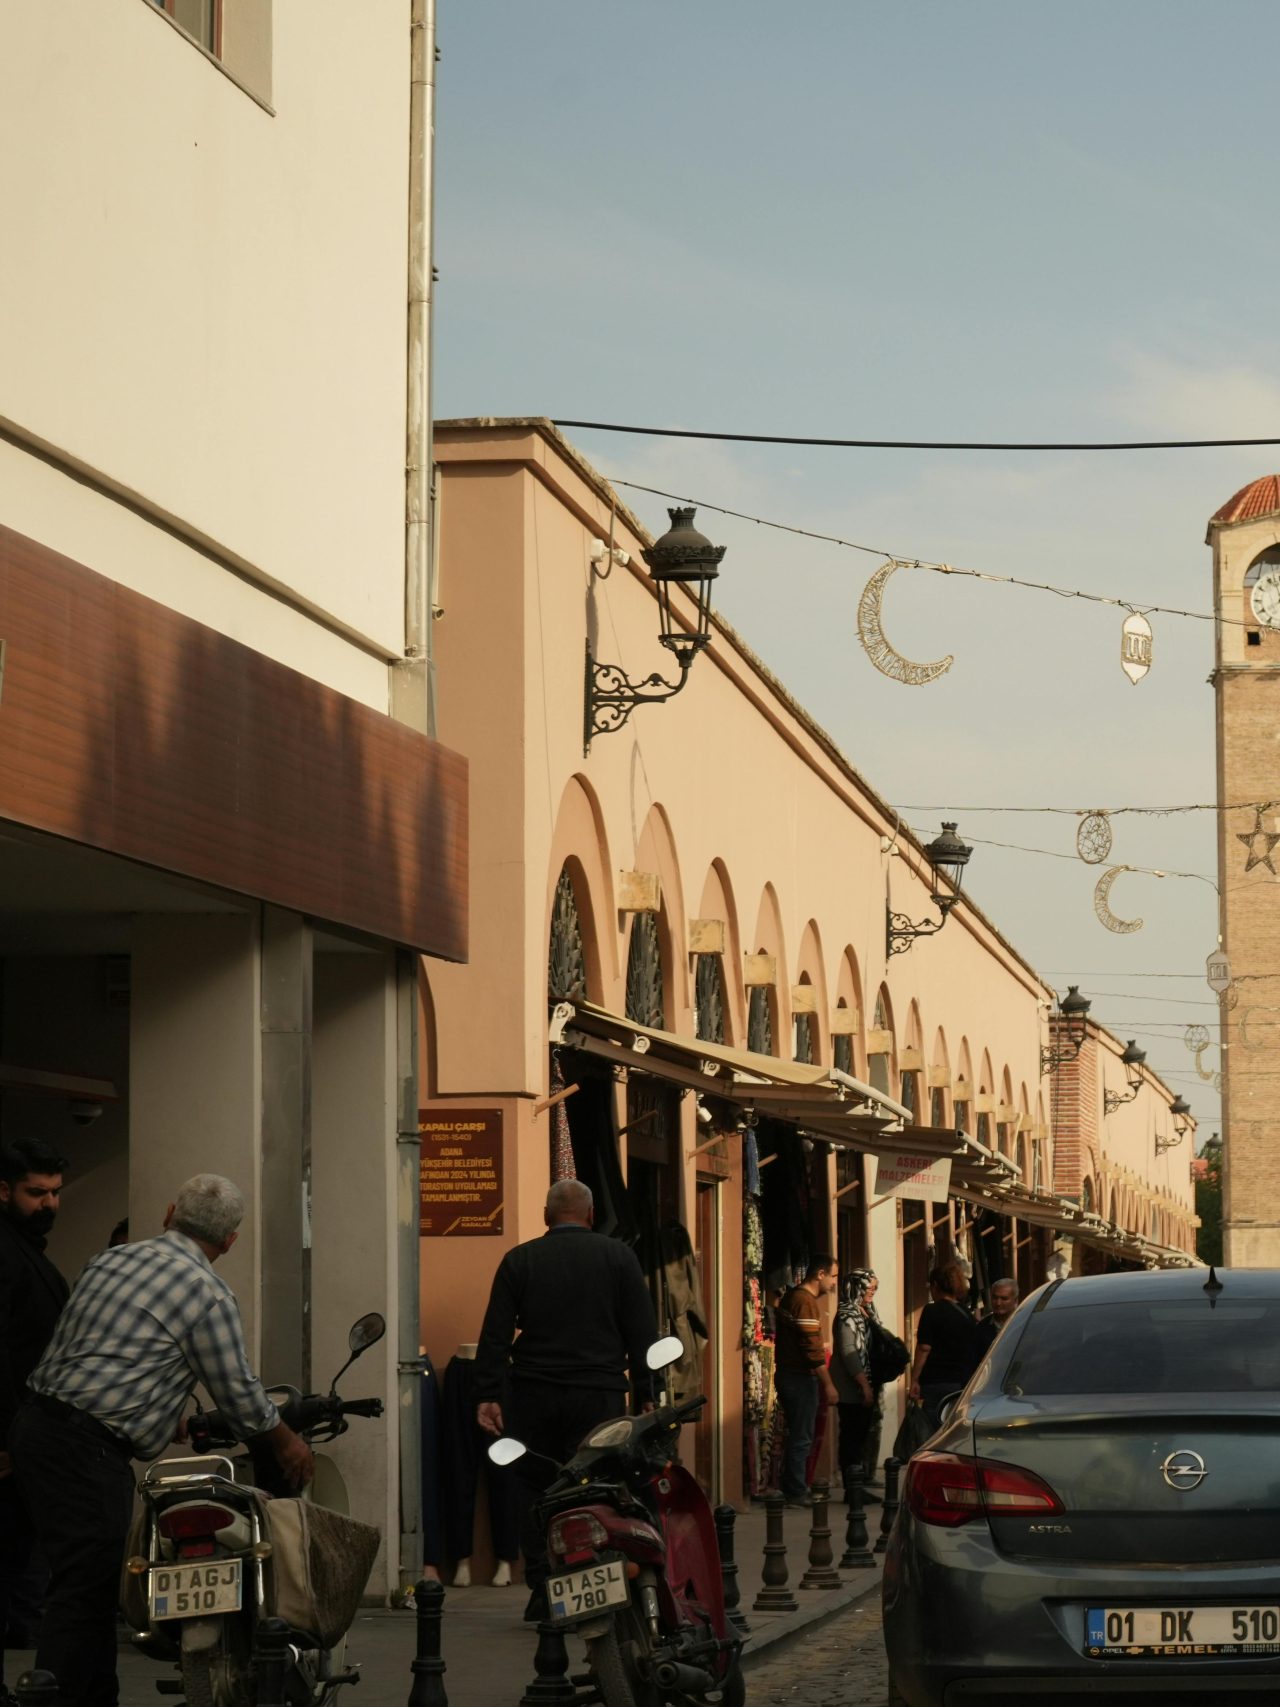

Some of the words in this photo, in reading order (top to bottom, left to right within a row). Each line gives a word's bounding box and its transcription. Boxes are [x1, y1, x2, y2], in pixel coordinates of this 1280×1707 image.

[417, 1122, 453, 1132] KAPALI
[455, 1122, 486, 1132] ÇARŞI
[440, 1147, 463, 1156] ADANA
[420, 1157, 453, 1169] YÜKŞEHİR
[454, 1157, 493, 1168] BELEDİYESİ
[420, 1170, 449, 1179] AFINDAN
[450, 1170, 468, 1179] 2024
[469, 1170, 496, 1179] YILINDA
[420, 1182, 453, 1190] TORASYON
[454, 1181, 497, 1190] UYGULAMASI
[1029, 1525, 1072, 1534] ASTRA
[158, 1570, 182, 1592] 01
[189, 1566, 235, 1589] AGJ
[552, 1577, 574, 1597] 01
[581, 1566, 620, 1590] ASL
[176, 1589, 216, 1611] 510
[571, 1588, 607, 1612] 780
[1090, 1631, 1104, 1641] TR
[1107, 1611, 1134, 1643] 01
[1161, 1610, 1194, 1642] DK
[1232, 1609, 1278, 1641] 510
[1150, 1645, 1218, 1655] TEMEL
